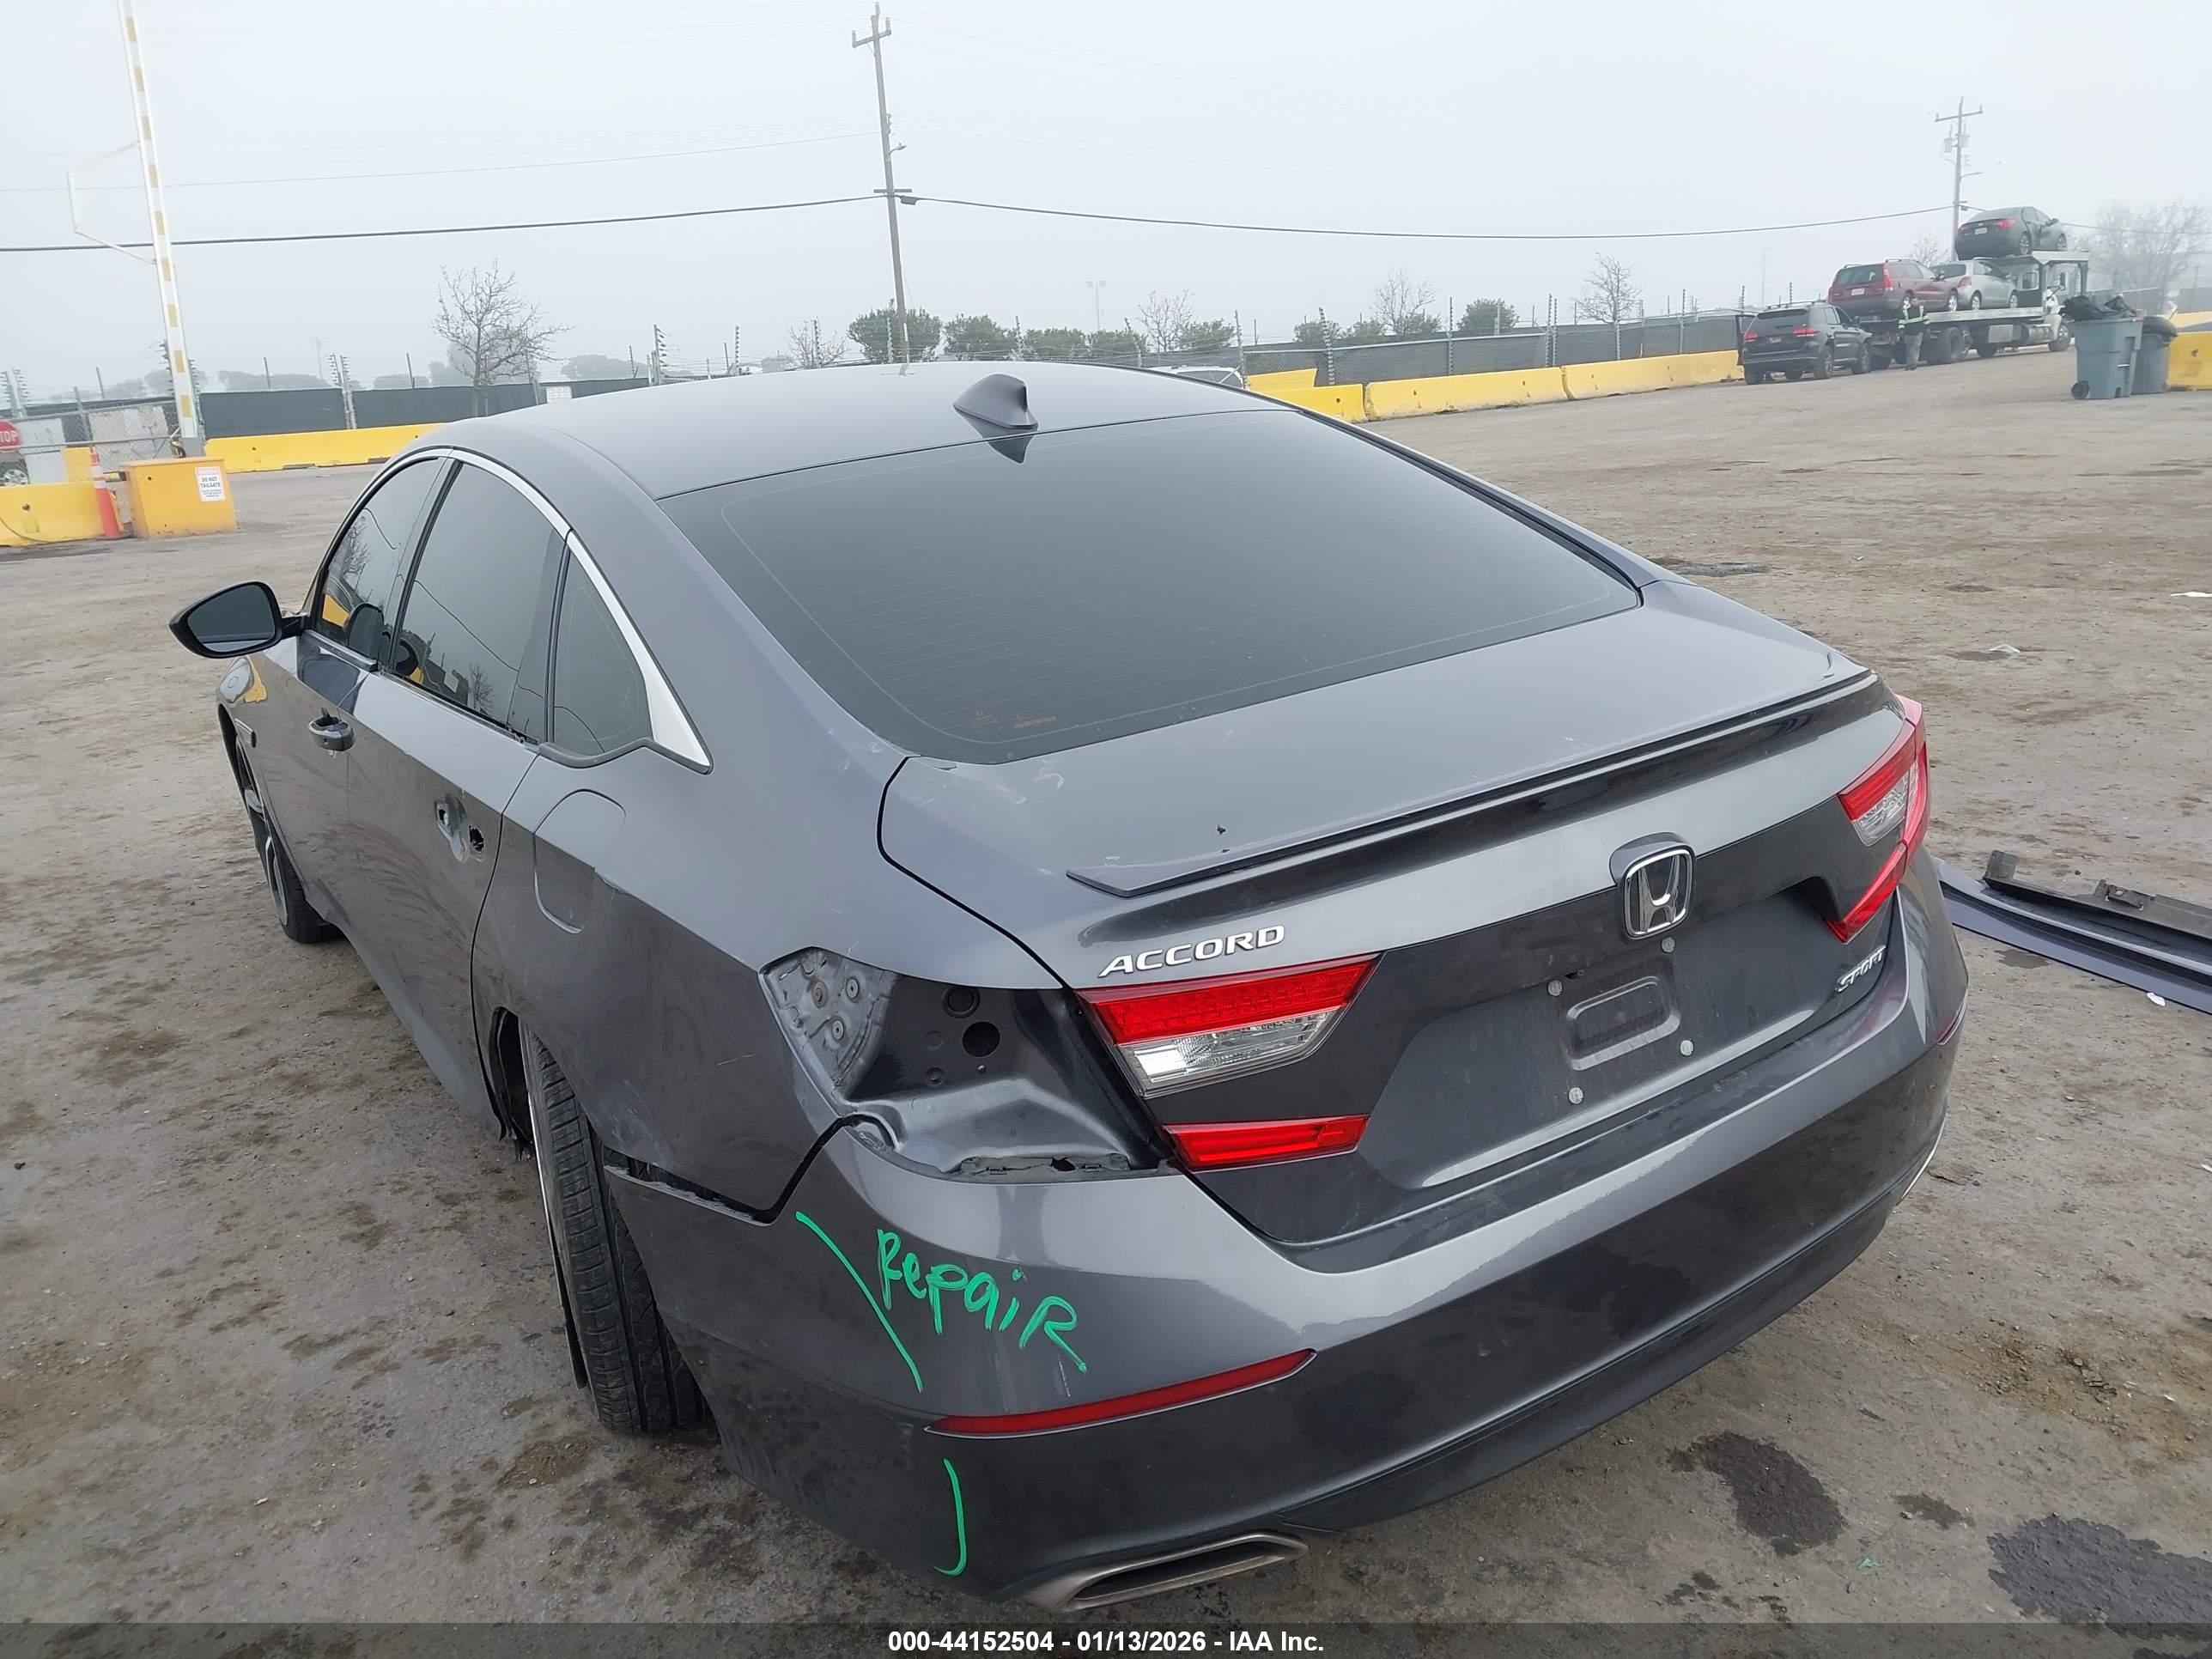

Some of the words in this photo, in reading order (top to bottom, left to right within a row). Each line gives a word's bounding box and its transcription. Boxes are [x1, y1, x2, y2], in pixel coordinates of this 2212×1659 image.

[0, 430, 18, 443] TOP
[1097, 925, 1285, 979] ACCORD
[1834, 945, 1887, 993] SPORT
